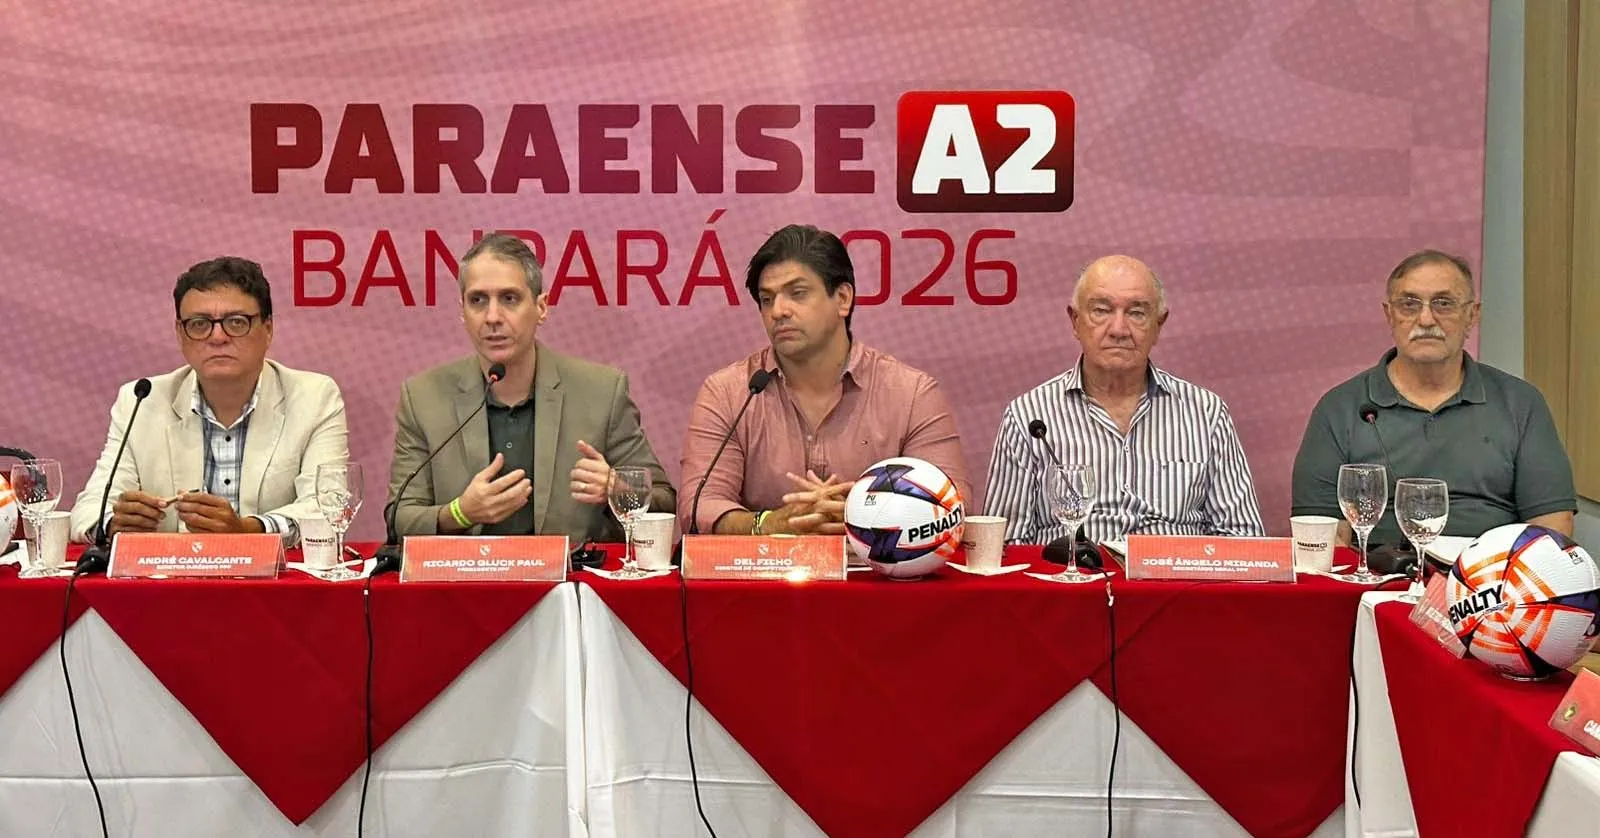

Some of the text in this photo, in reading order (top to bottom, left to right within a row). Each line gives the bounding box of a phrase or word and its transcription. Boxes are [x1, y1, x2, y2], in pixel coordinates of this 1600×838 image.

[250, 104, 1056, 194] PARAENSE A2
[138, 554, 252, 565] ANDRÉ CAVALCANTE
[423, 559, 475, 568] RICARDO
[516, 559, 546, 567] PAUL
[733, 558, 793, 566] DEL FILHO
[1142, 557, 1279, 569] JOSÉ ÂNGELO MIRANDA
